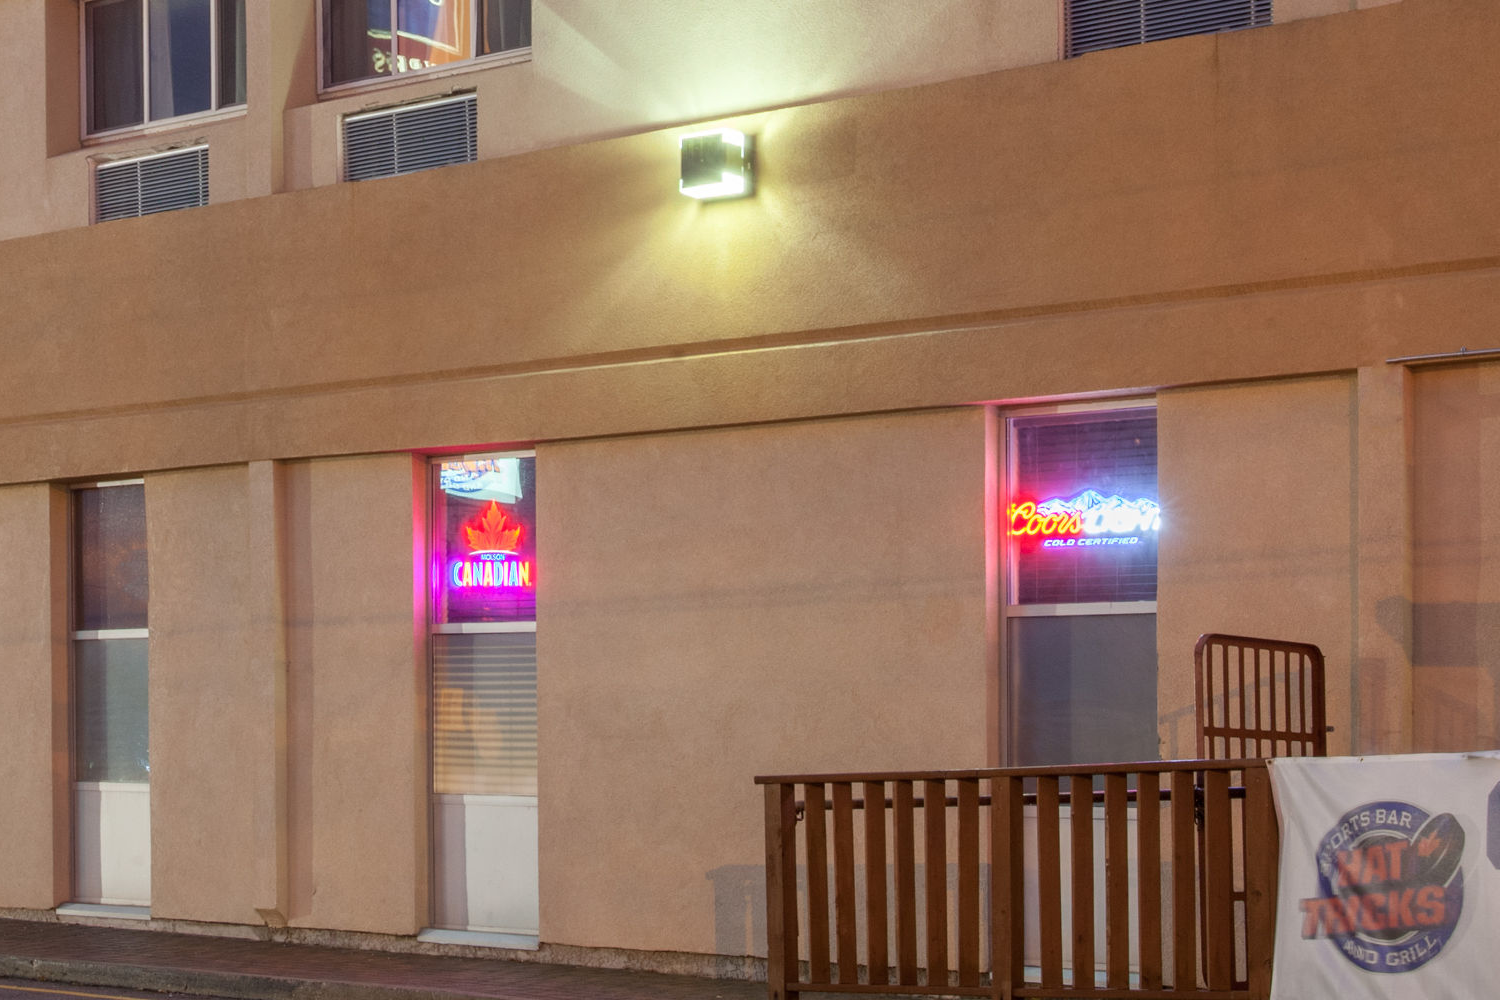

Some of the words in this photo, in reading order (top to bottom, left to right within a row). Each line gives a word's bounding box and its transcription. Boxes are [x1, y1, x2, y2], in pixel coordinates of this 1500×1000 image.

[1009, 501, 1083, 536] Coors
[1043, 538, 1076, 547] COLD
[1077, 536, 1139, 547] CERTIFIED
[453, 560, 530, 587] CANADIAN
[1375, 808, 1412, 829] BAR
[1336, 841, 1408, 887] HAT
[1385, 935, 1437, 967] GRILL
